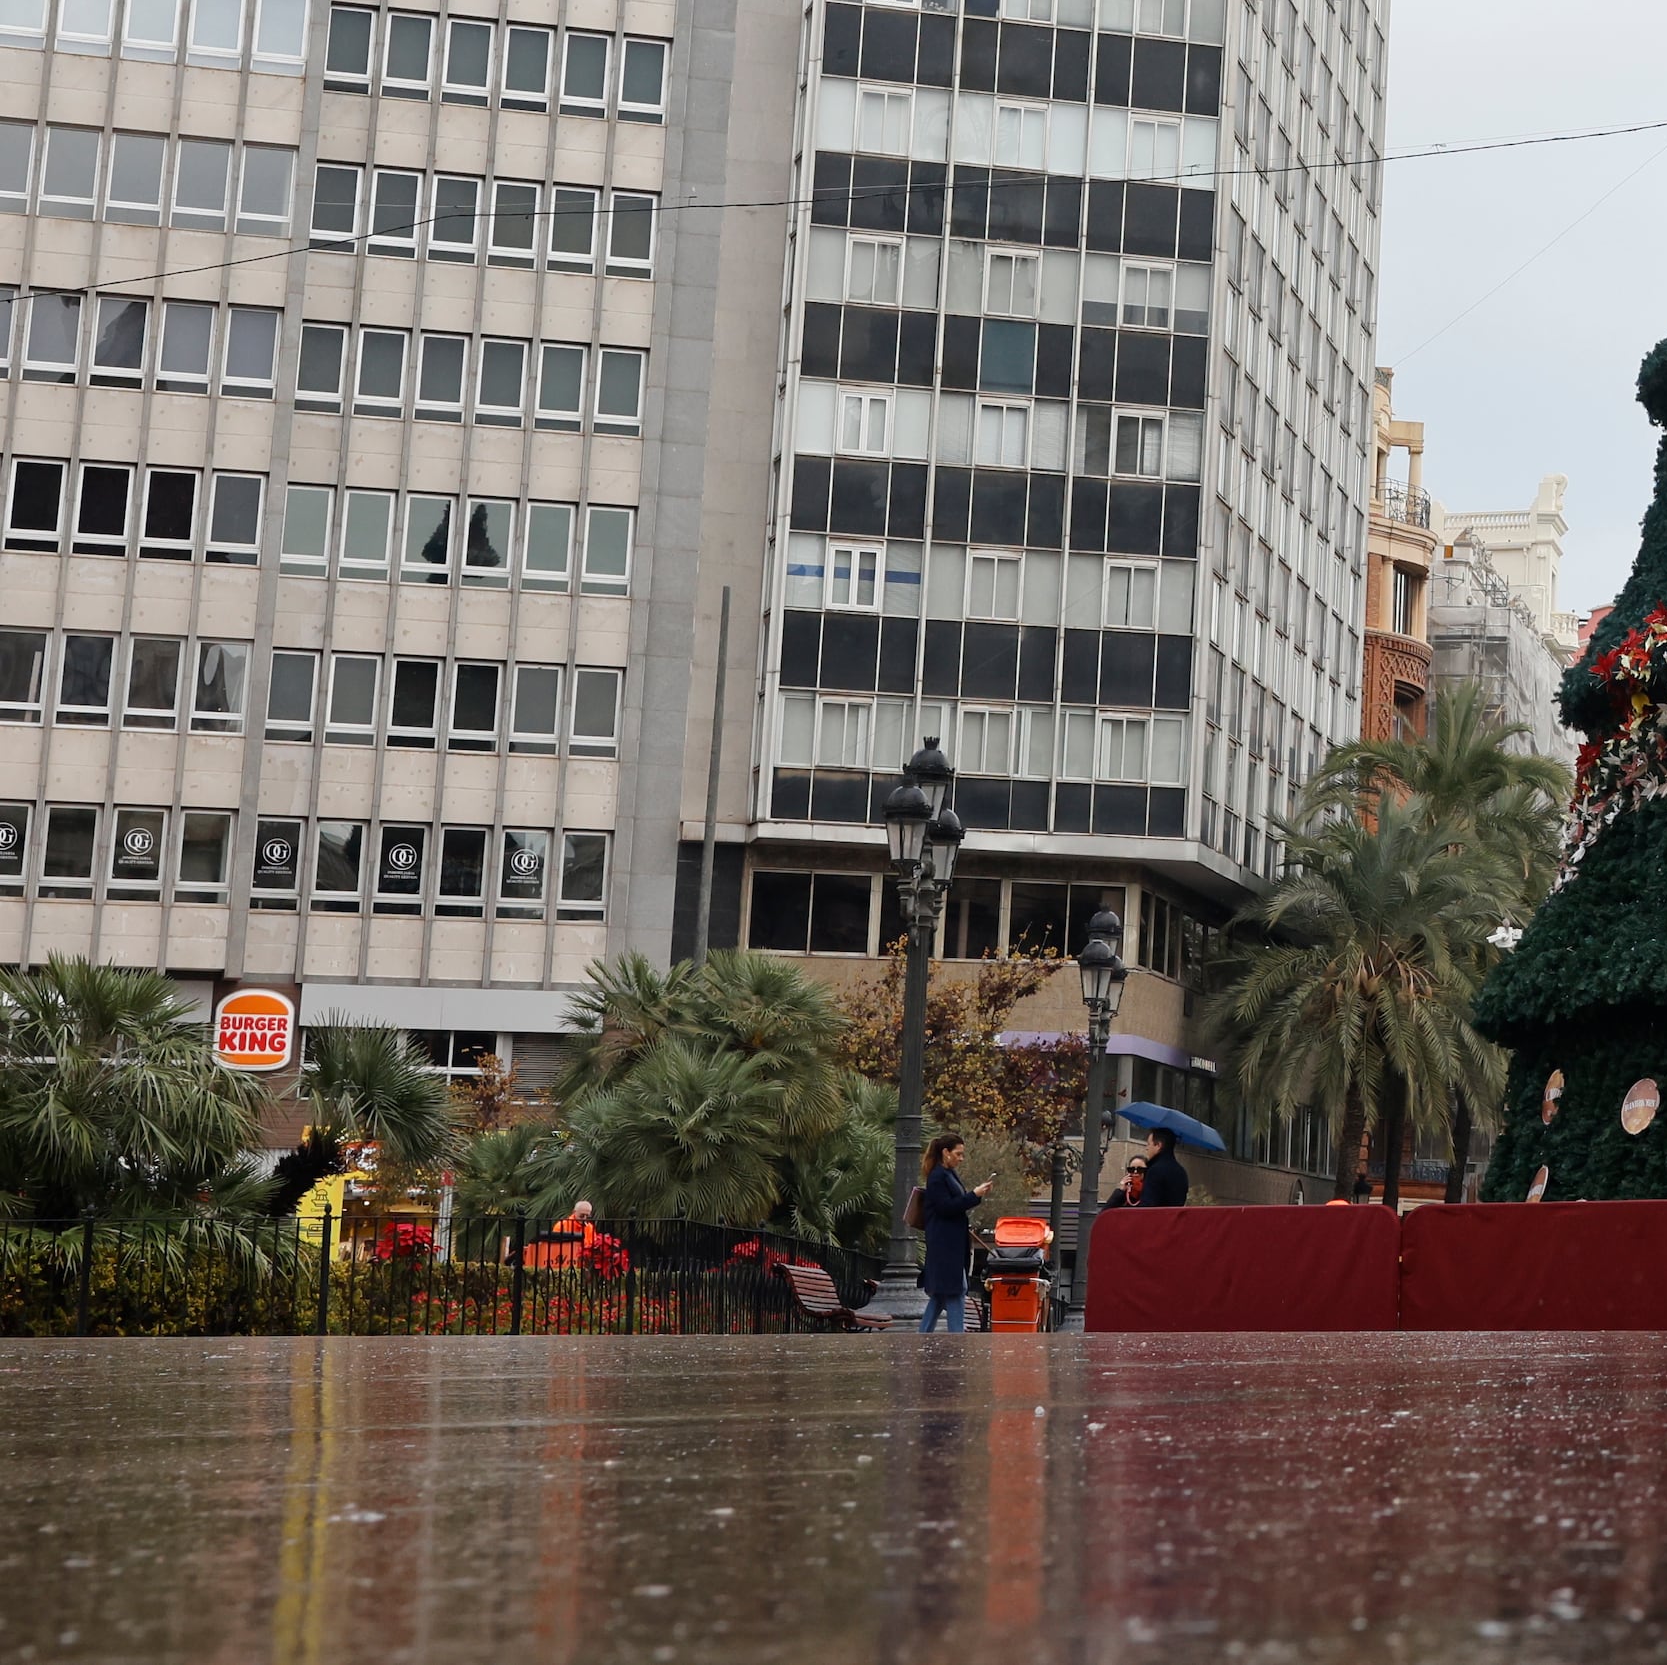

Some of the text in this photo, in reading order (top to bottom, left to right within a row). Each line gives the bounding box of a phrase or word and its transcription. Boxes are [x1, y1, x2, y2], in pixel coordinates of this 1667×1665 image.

[127, 832, 150, 852] QG
[266, 843, 288, 862] QG
[392, 848, 414, 867] QG
[514, 853, 536, 872] QG
[220, 1016, 288, 1031] BURGER
[219, 1031, 286, 1052] KING
